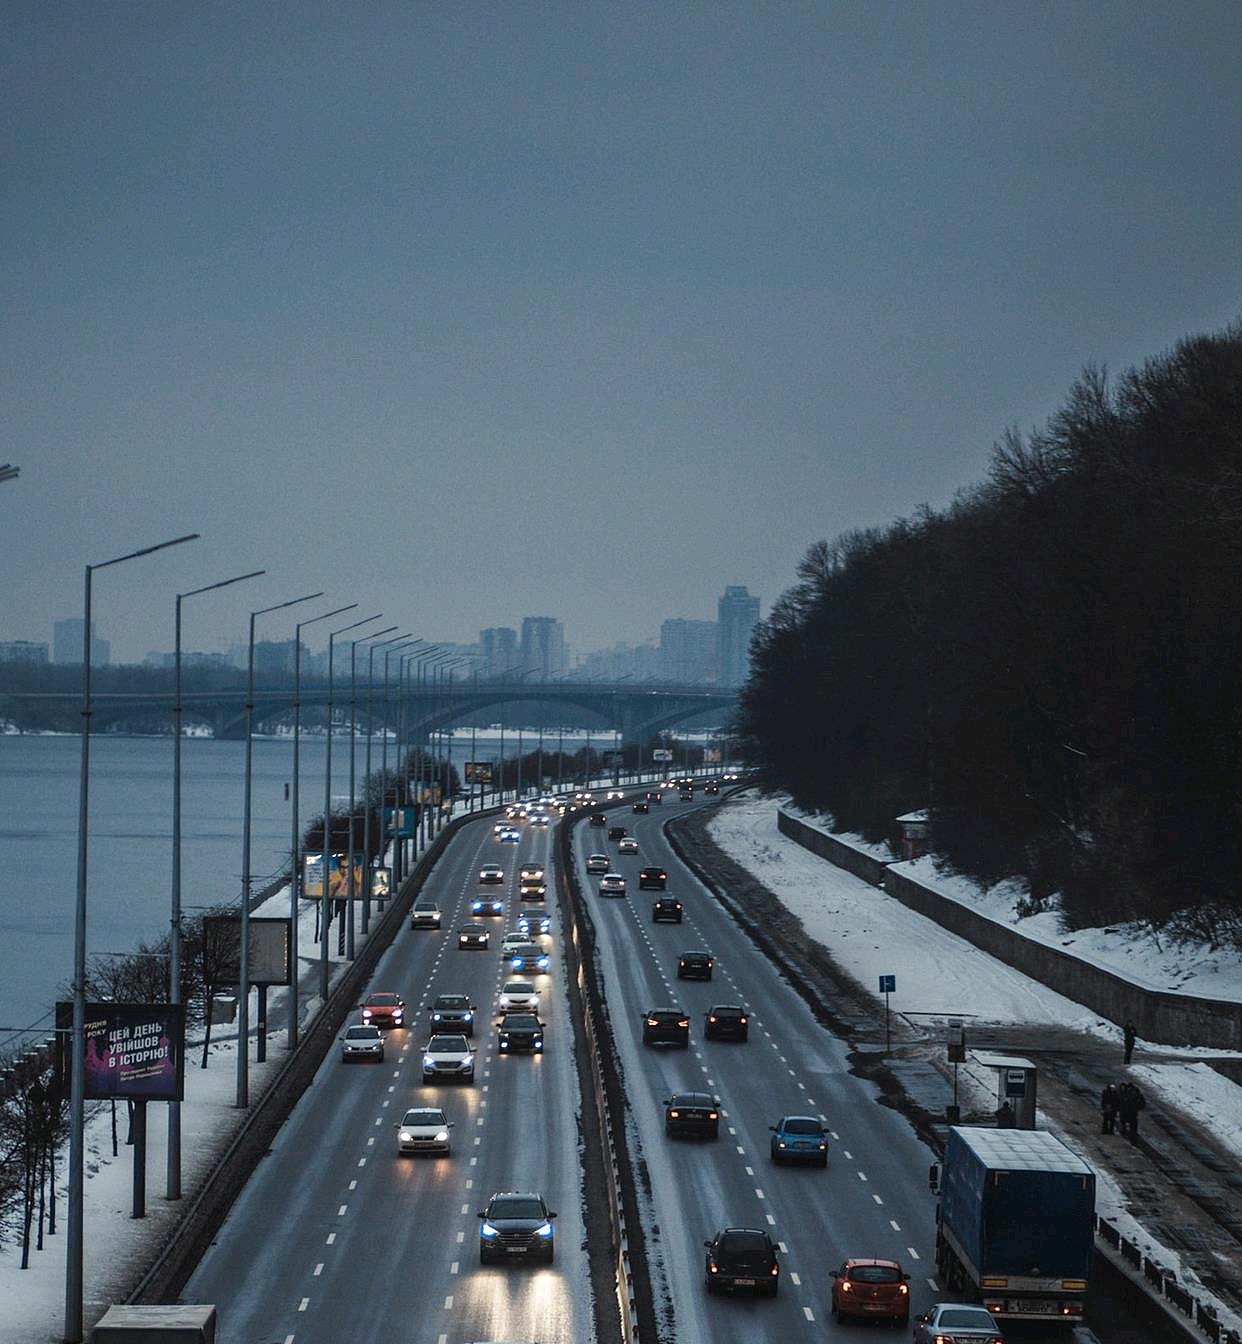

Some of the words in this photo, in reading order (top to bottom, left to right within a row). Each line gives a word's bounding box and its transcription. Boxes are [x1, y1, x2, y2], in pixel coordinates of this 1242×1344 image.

[109, 1026, 130, 1043] ЦЕЙ
[133, 1022, 162, 1039] ДЕНЬ
[109, 1036, 159, 1055] УВІЙШОВ
[108, 1057, 116, 1068] В
[119, 1046, 168, 1065] ІСТОРІЮ!
